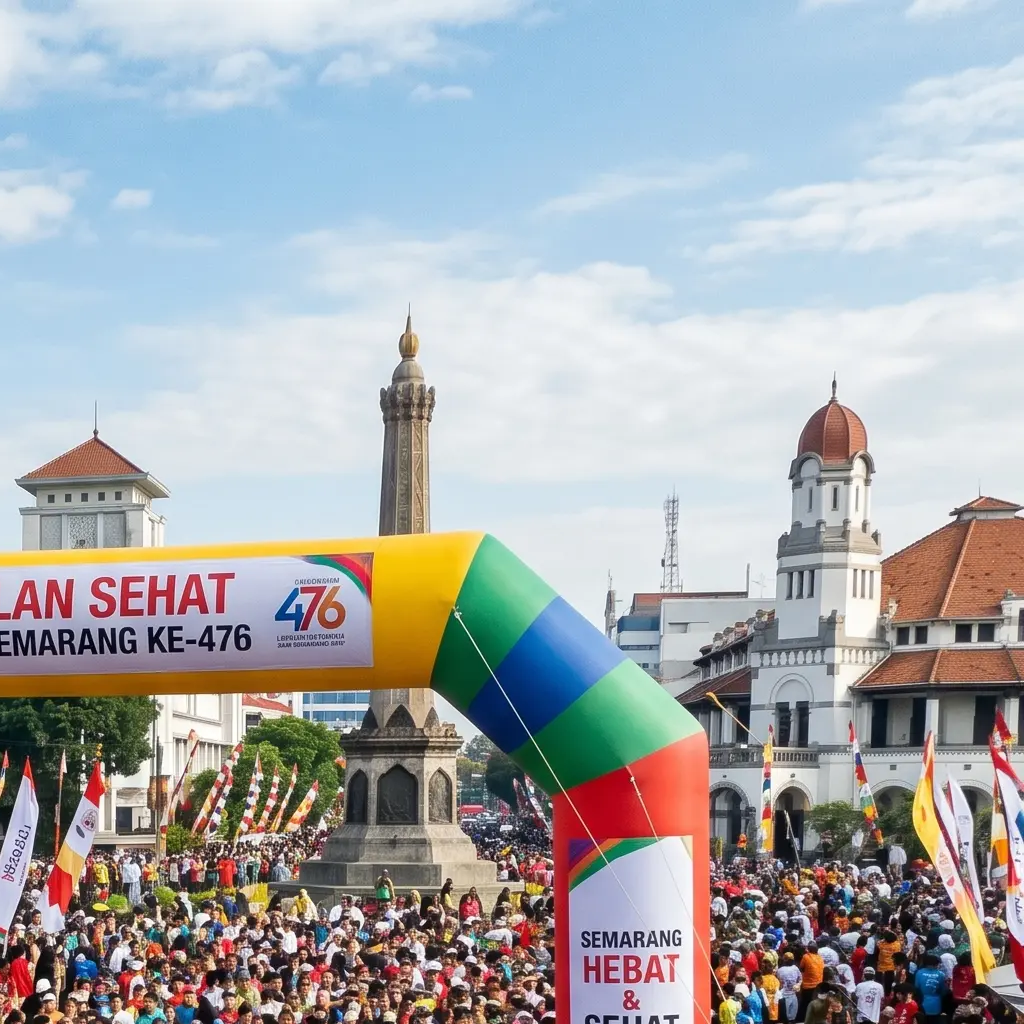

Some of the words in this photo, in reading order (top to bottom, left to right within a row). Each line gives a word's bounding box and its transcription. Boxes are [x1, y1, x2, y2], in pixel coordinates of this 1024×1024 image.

[89, 572, 235, 619] SEHAT
[274, 586, 346, 631] 476
[148, 622, 252, 654] KE-476
[581, 929, 682, 948] SEMARANG
[583, 954, 680, 983] HEBAT
[623, 989, 640, 1011] &
